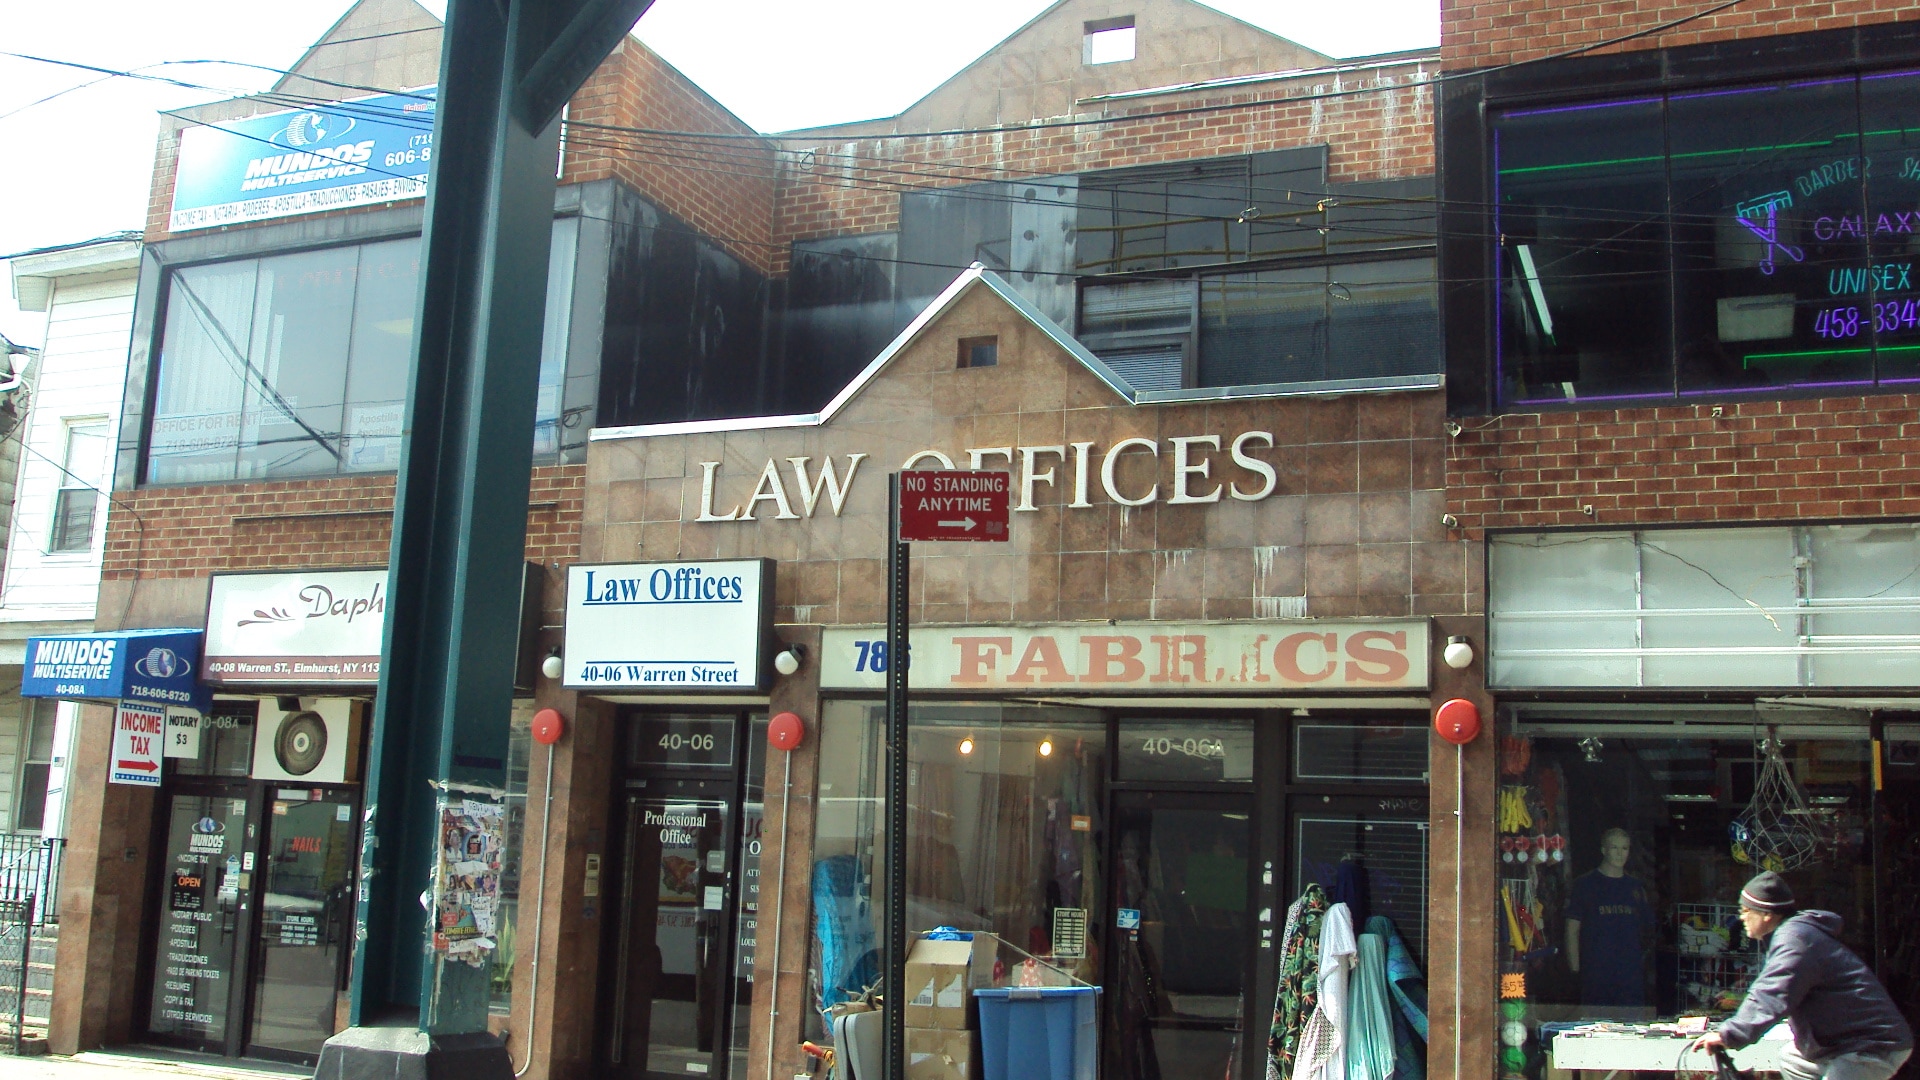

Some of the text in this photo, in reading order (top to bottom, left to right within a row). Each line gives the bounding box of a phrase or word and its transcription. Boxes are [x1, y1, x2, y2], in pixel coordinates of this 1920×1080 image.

[244, 140, 376, 179] MUNDOS
[240, 162, 369, 192] MULTISERVICE
[242, 199, 270, 217] PODERES
[310, 186, 357, 206] TRADUCCIONES
[361, 181, 389, 199] PASAJES
[1829, 263, 1911, 295] UNISEX
[154, 413, 258, 434] OFFICE FOR RENT
[694, 430, 1277, 523] LAW FICES
[907, 477, 1003, 493] NO STANDING
[918, 497, 992, 512] ANYTIME
[585, 567, 742, 602] Law Offices
[299, 582, 384, 624] Daph
[35, 639, 117, 665] MUNDOS
[855, 641, 911, 673] 78
[950, 630, 1410, 685] FABRICS
[33, 664, 111, 680] MULTISERVICE
[209, 662, 234, 673] 40-08
[237, 662, 272, 673] Warren
[294, 662, 341, 675] Elmhurst,
[343, 662, 359, 673] NY
[581, 665, 739, 682] 40-06 Warren Street
[56, 684, 85, 695] 40-08A
[131, 685, 190, 702] 718-606-8720
[120, 711, 162, 735] INCOME
[168, 714, 199, 729] NOTARY
[130, 735, 150, 755] TAX
[176, 732, 187, 746] $3
[659, 733, 714, 750] 40-06
[1142, 738, 1225, 756] 40-06A
[644, 811, 707, 828] Professional
[190, 833, 225, 847] MUNDOS
[292, 836, 322, 853] NAILS
[660, 829, 691, 845] Office
[199, 855, 209, 863] TAX
[178, 876, 201, 887] OPEN
[193, 912, 212, 921] PUBLIC
[179, 967, 185, 976] DE
[185, 968, 203, 978] PARKING
[203, 970, 220, 979] TICKETS
[184, 997, 194, 1006] FAX
[166, 1010, 184, 1020] OTROS
[185, 1012, 212, 1023] SERVICIOS
